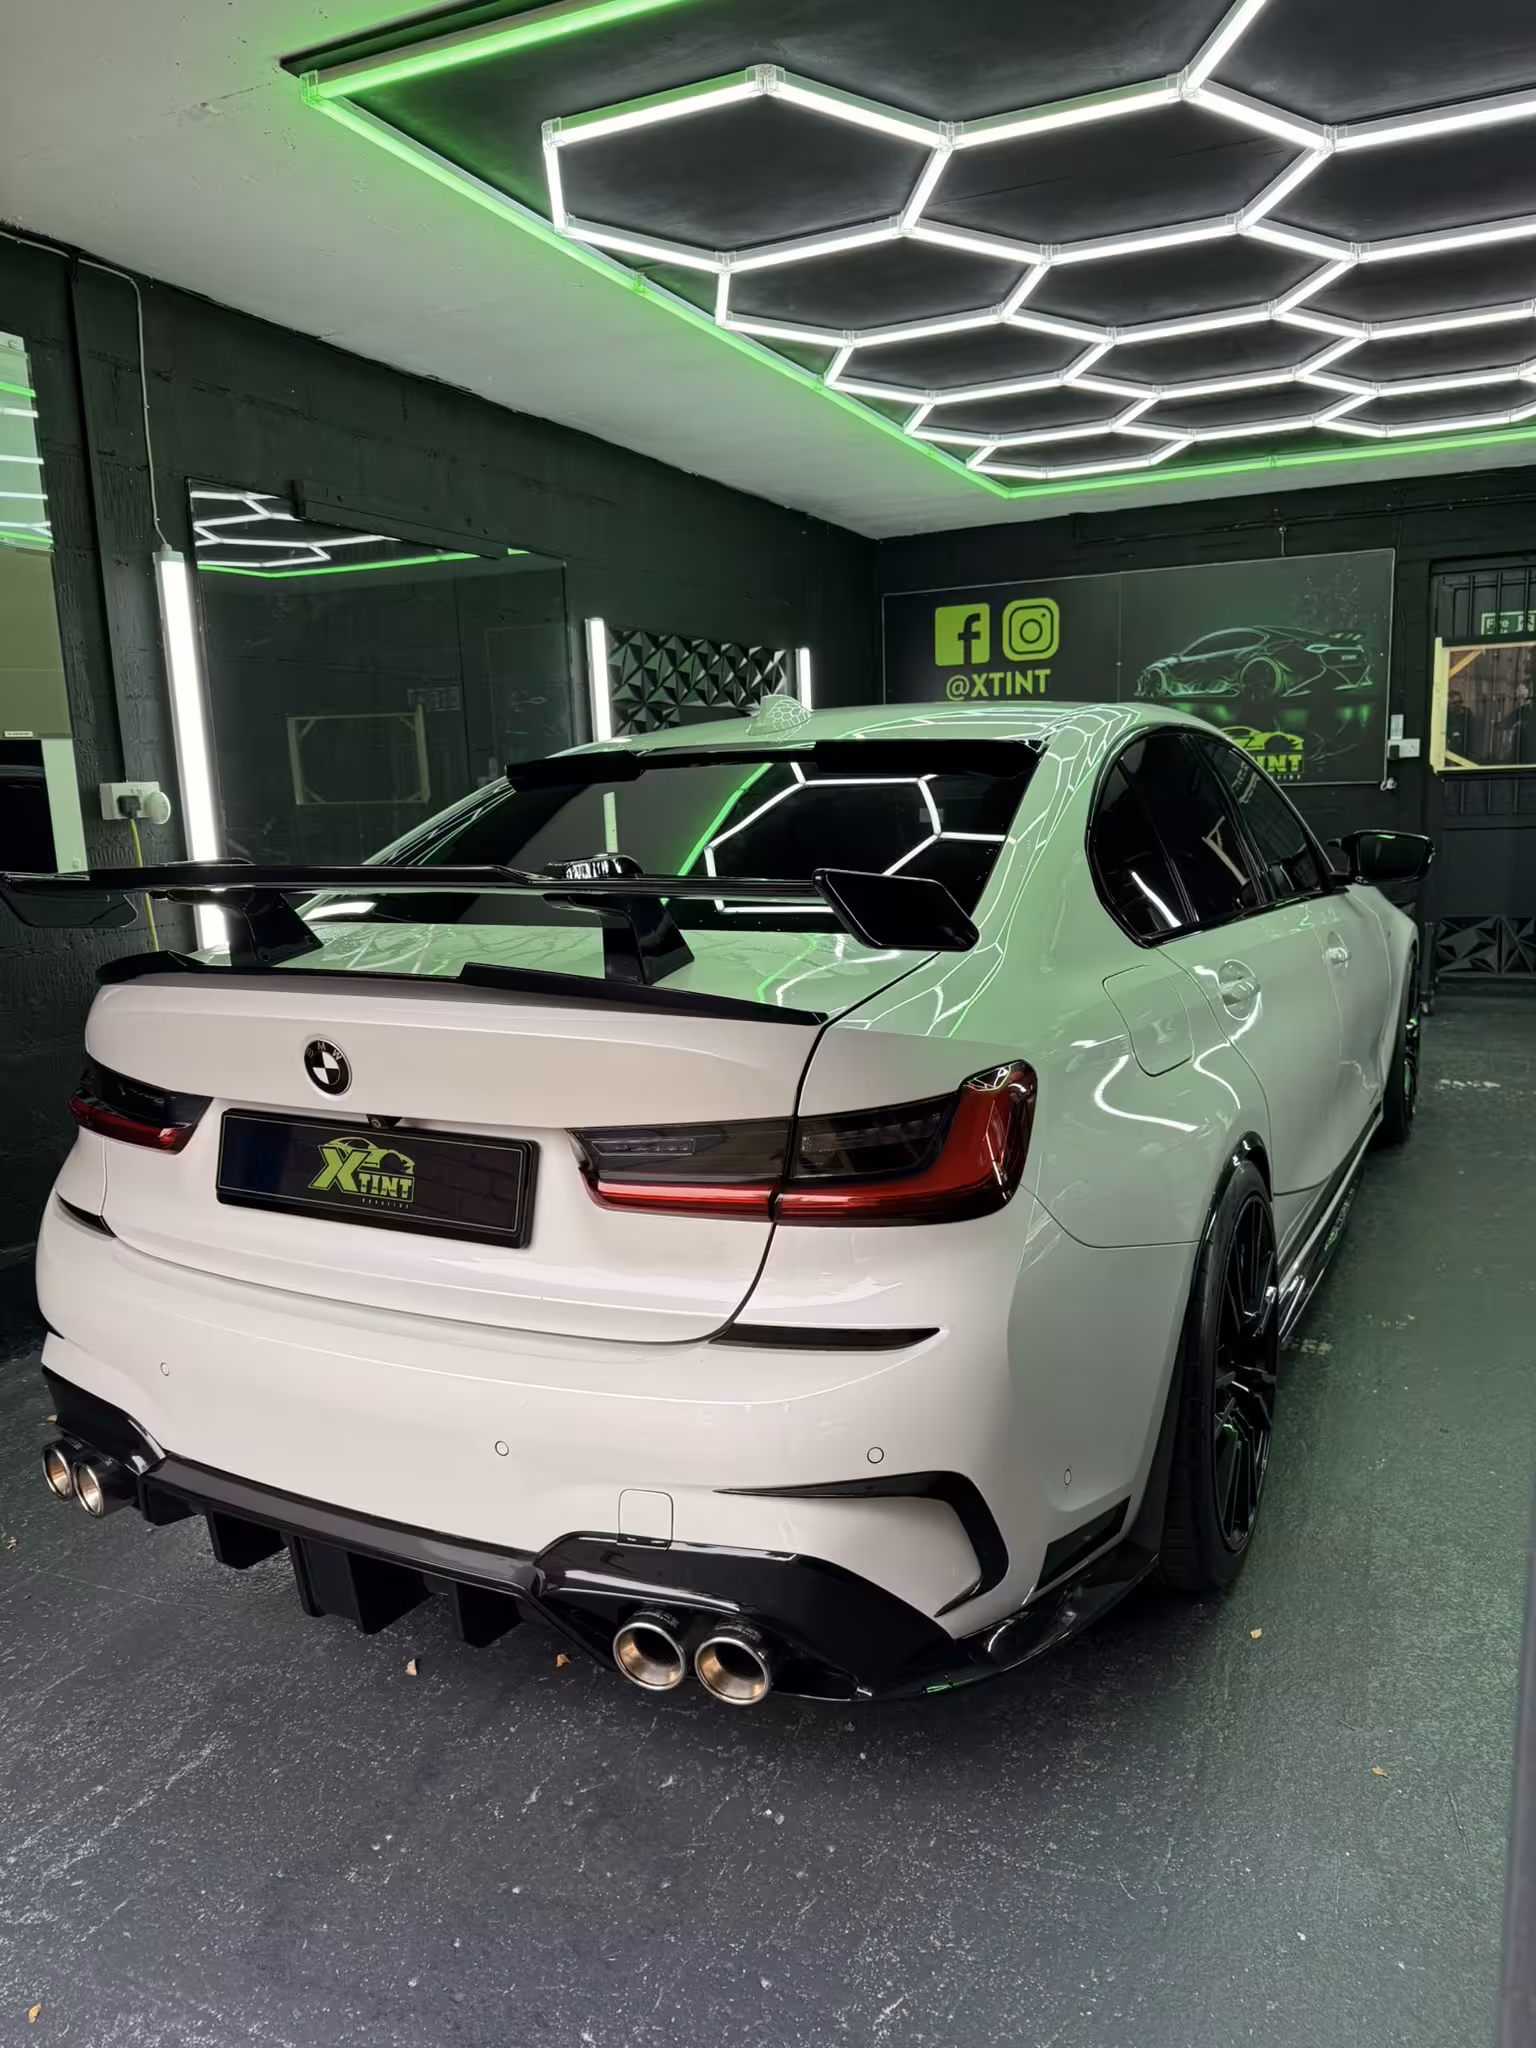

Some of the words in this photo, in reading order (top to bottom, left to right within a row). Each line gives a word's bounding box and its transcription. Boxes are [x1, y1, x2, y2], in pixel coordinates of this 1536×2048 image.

[1486, 618, 1509, 630] Fre
[946, 668, 1051, 701] @XTINT
[1252, 752, 1303, 774] INT
[307, 1041, 343, 1061] BMW
[308, 1145, 414, 1203] XTINT
